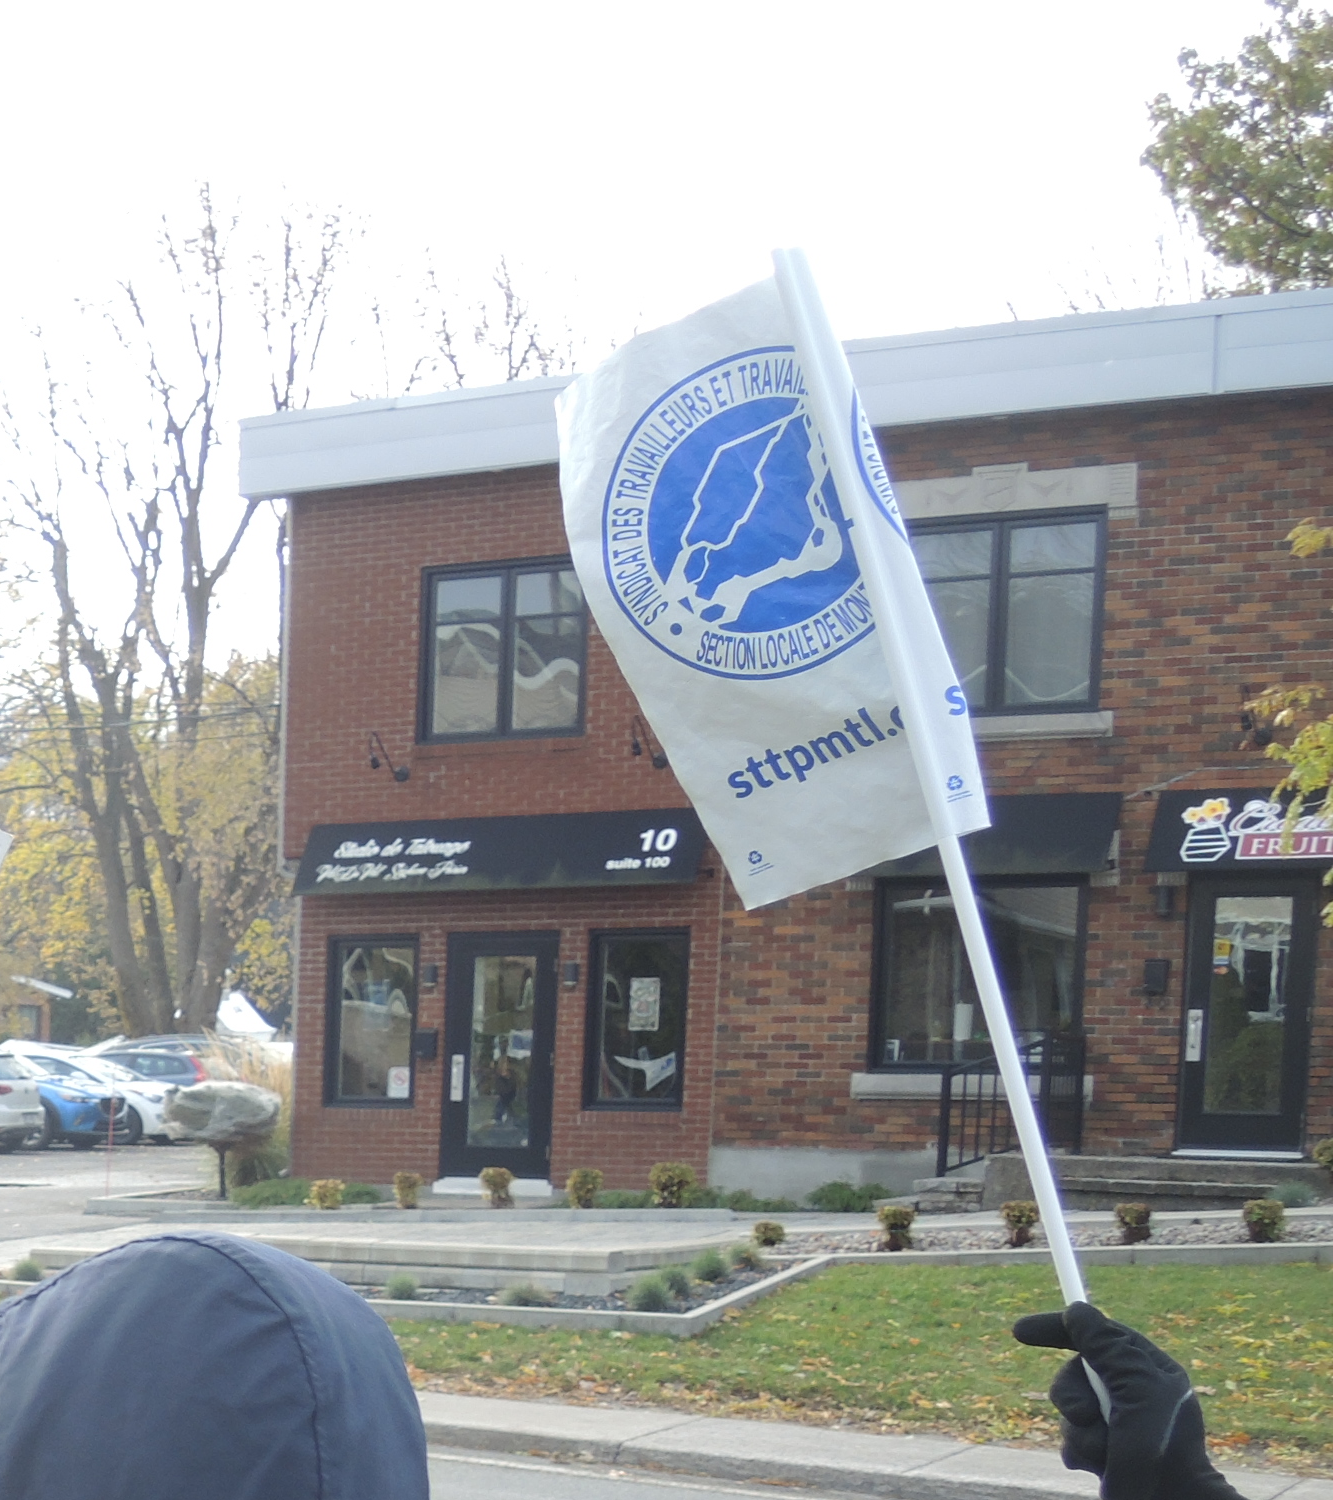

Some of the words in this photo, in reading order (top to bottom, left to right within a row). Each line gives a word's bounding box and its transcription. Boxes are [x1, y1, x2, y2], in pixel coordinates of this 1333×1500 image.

[709, 370, 733, 407] ET
[617, 385, 714, 501] TRAVAILLEURS
[611, 506, 644, 542] DES
[613, 547, 669, 627] SYNDICAT
[696, 629, 756, 670] SECTION
[760, 625, 819, 670] LOCALE
[813, 613, 844, 649] DE
[639, 827, 678, 852] 10
[605, 857, 640, 871] suite
[644, 856, 671, 869] 100
